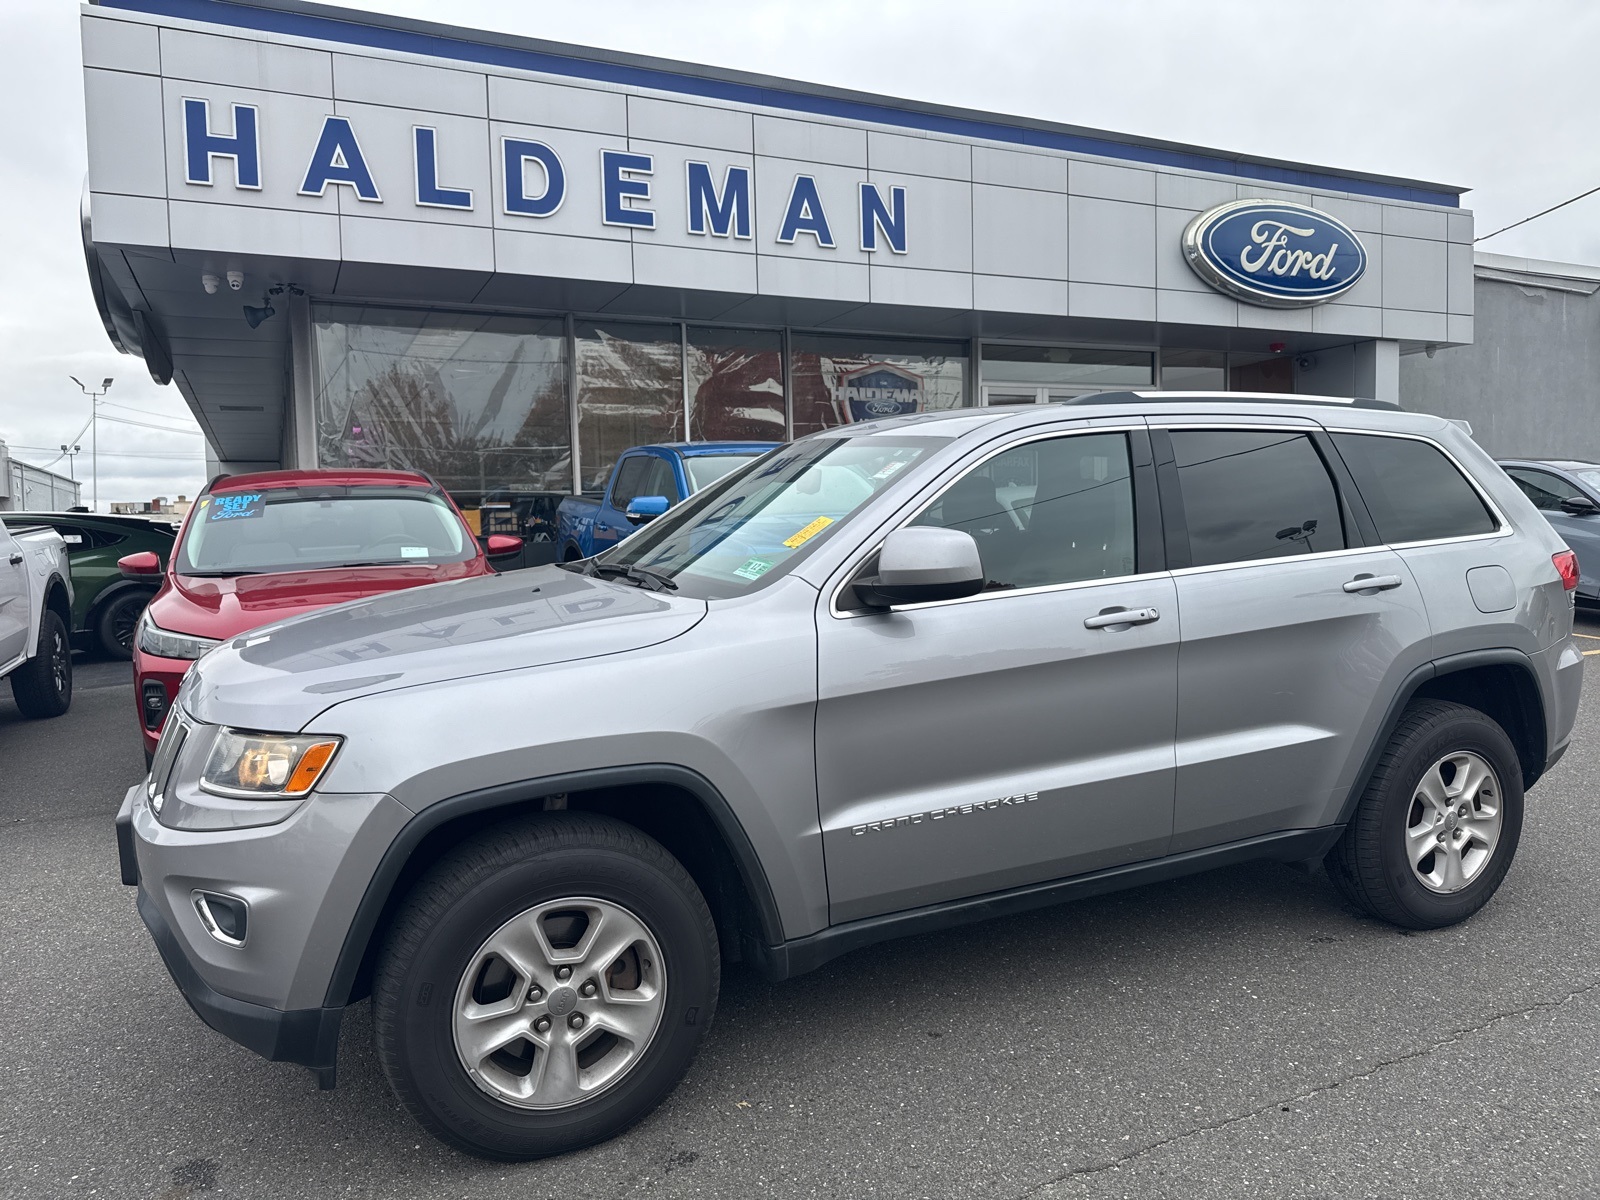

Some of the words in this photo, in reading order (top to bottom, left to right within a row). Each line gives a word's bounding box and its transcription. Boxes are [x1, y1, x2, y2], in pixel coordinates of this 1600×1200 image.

[182, 96, 907, 256] HALDEMAN
[1241, 220, 1338, 281] Ford
[872, 401, 895, 413] Ford
[214, 494, 262, 505] READY
[223, 502, 248, 511] SET
[211, 509, 255, 520] Ford
[851, 813, 924, 836] GRAND
[930, 791, 1039, 820] CHEROKEE
